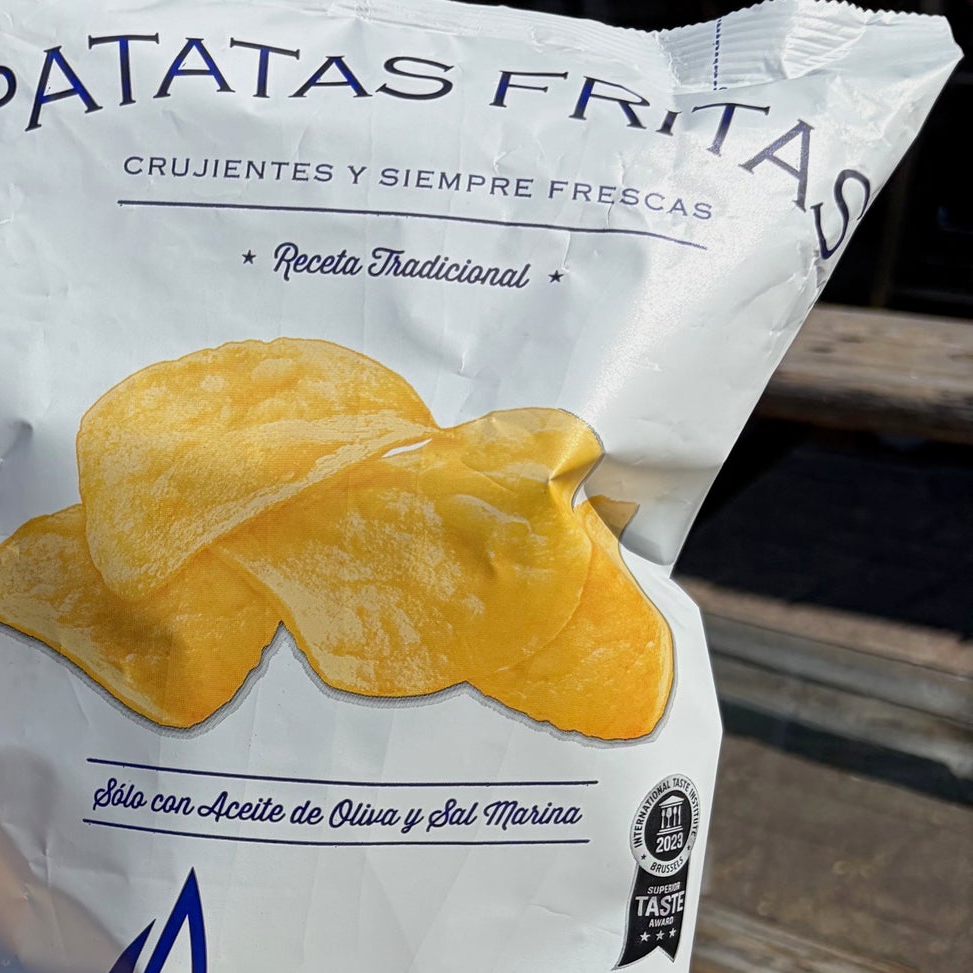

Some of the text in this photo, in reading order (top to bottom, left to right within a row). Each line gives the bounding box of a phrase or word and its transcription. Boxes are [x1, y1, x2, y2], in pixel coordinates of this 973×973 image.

[123, 155, 713, 221] CRUJIENTES Y SIEMPRE FRESCAS
[273, 241, 530, 288] Receta Tradicional
[93, 777, 583, 833] Sólo con Aceite de Oliva y Sal Marina
[633, 778, 699, 849] INTERNATIONAL TASTE INSTITUTE
[655, 832, 684, 854] 2023
[650, 856, 684, 874] BRUSSELS
[647, 881, 681, 895] SUPERIOR
[635, 889, 686, 917] TASTE
[648, 916, 674, 928] AWARD
